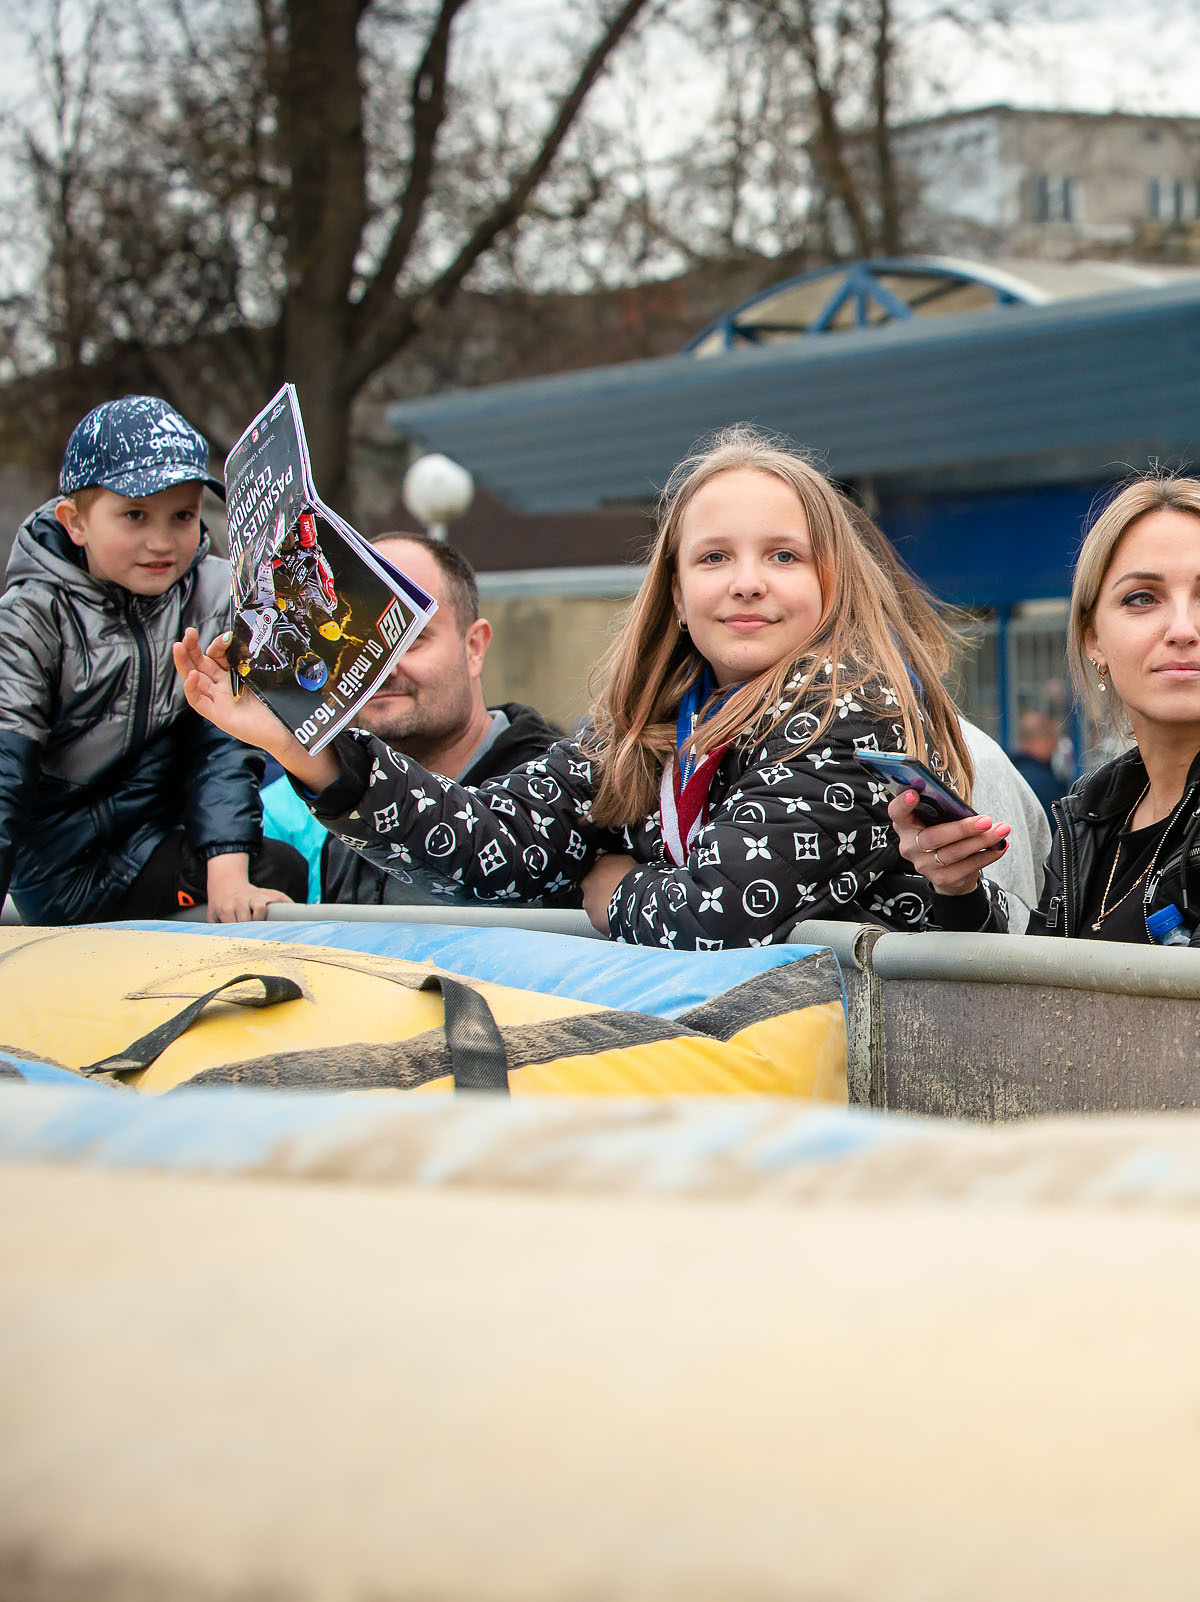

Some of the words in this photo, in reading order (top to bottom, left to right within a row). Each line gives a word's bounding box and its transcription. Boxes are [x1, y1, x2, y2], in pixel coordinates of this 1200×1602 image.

[150, 433, 195, 451] adidas
[243, 465, 294, 545] PASAULES
[379, 599, 407, 650] U21
[363, 639, 384, 659] 07.
[337, 655, 373, 699] maijā
[294, 702, 336, 745] 16.00
